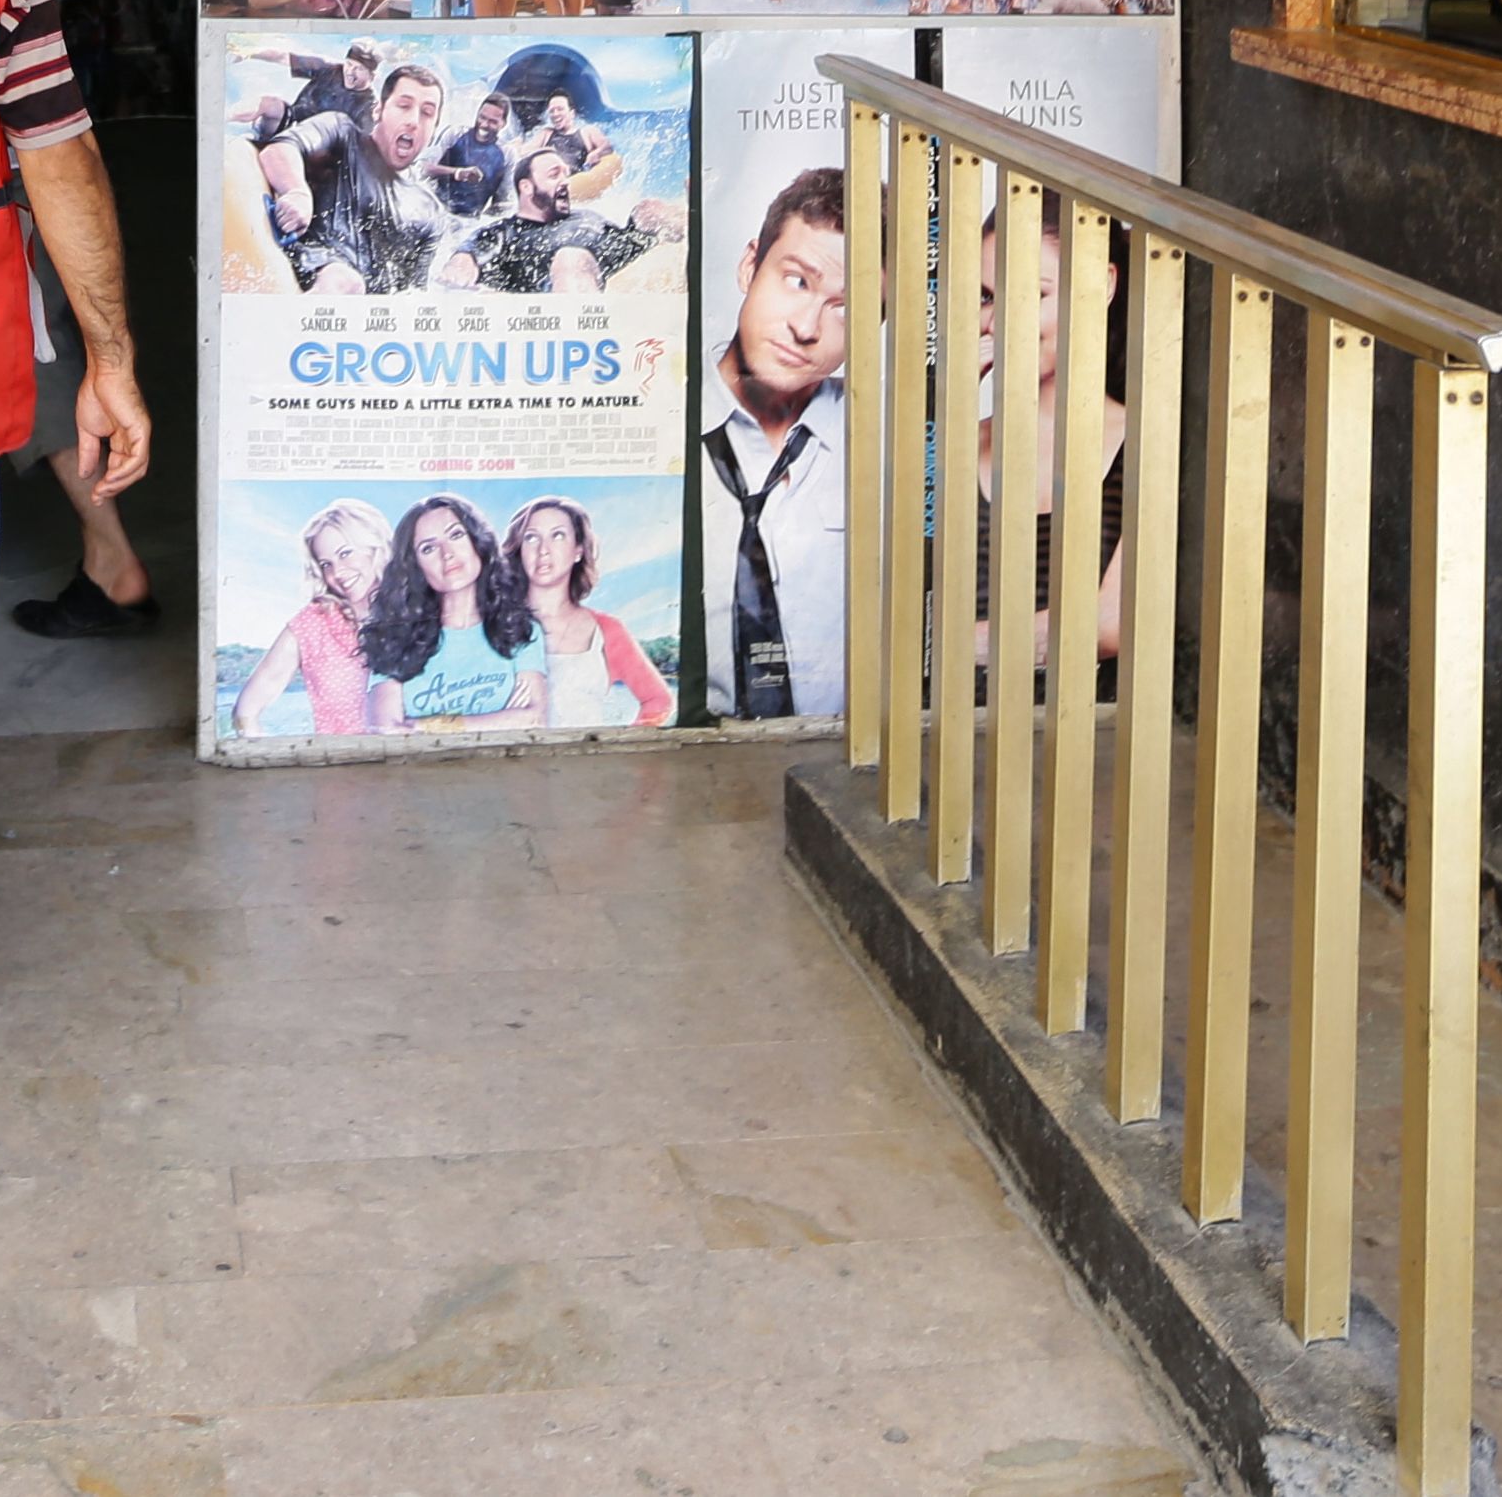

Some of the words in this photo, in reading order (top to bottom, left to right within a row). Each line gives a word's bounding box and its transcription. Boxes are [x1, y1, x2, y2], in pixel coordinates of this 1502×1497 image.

[774, 82, 845, 105] JUST
[1010, 79, 1076, 101] MILA
[300, 317, 347, 332] SANDLER
[364, 317, 397, 332] JAMES
[414, 317, 441, 331] ROCK
[458, 317, 490, 331] SPADE
[507, 317, 561, 331] SCHNEIDER
[577, 316, 610, 330] HAYEK
[289, 340, 508, 386] GROWN
[524, 339, 622, 385] UPS
[268, 398, 311, 410] SOME
[316, 398, 356, 410] GUYS
[361, 398, 399, 410] NEED
[404, 398, 414, 410] A
[420, 398, 462, 410] LITTLE
[468, 398, 514, 410] EXTRA
[518, 397, 553, 409] TIME
[558, 397, 576, 409] TO
[581, 396, 645, 409] MATURE.
[419, 460, 474, 472] COMING
[477, 459, 515, 472] SOON
